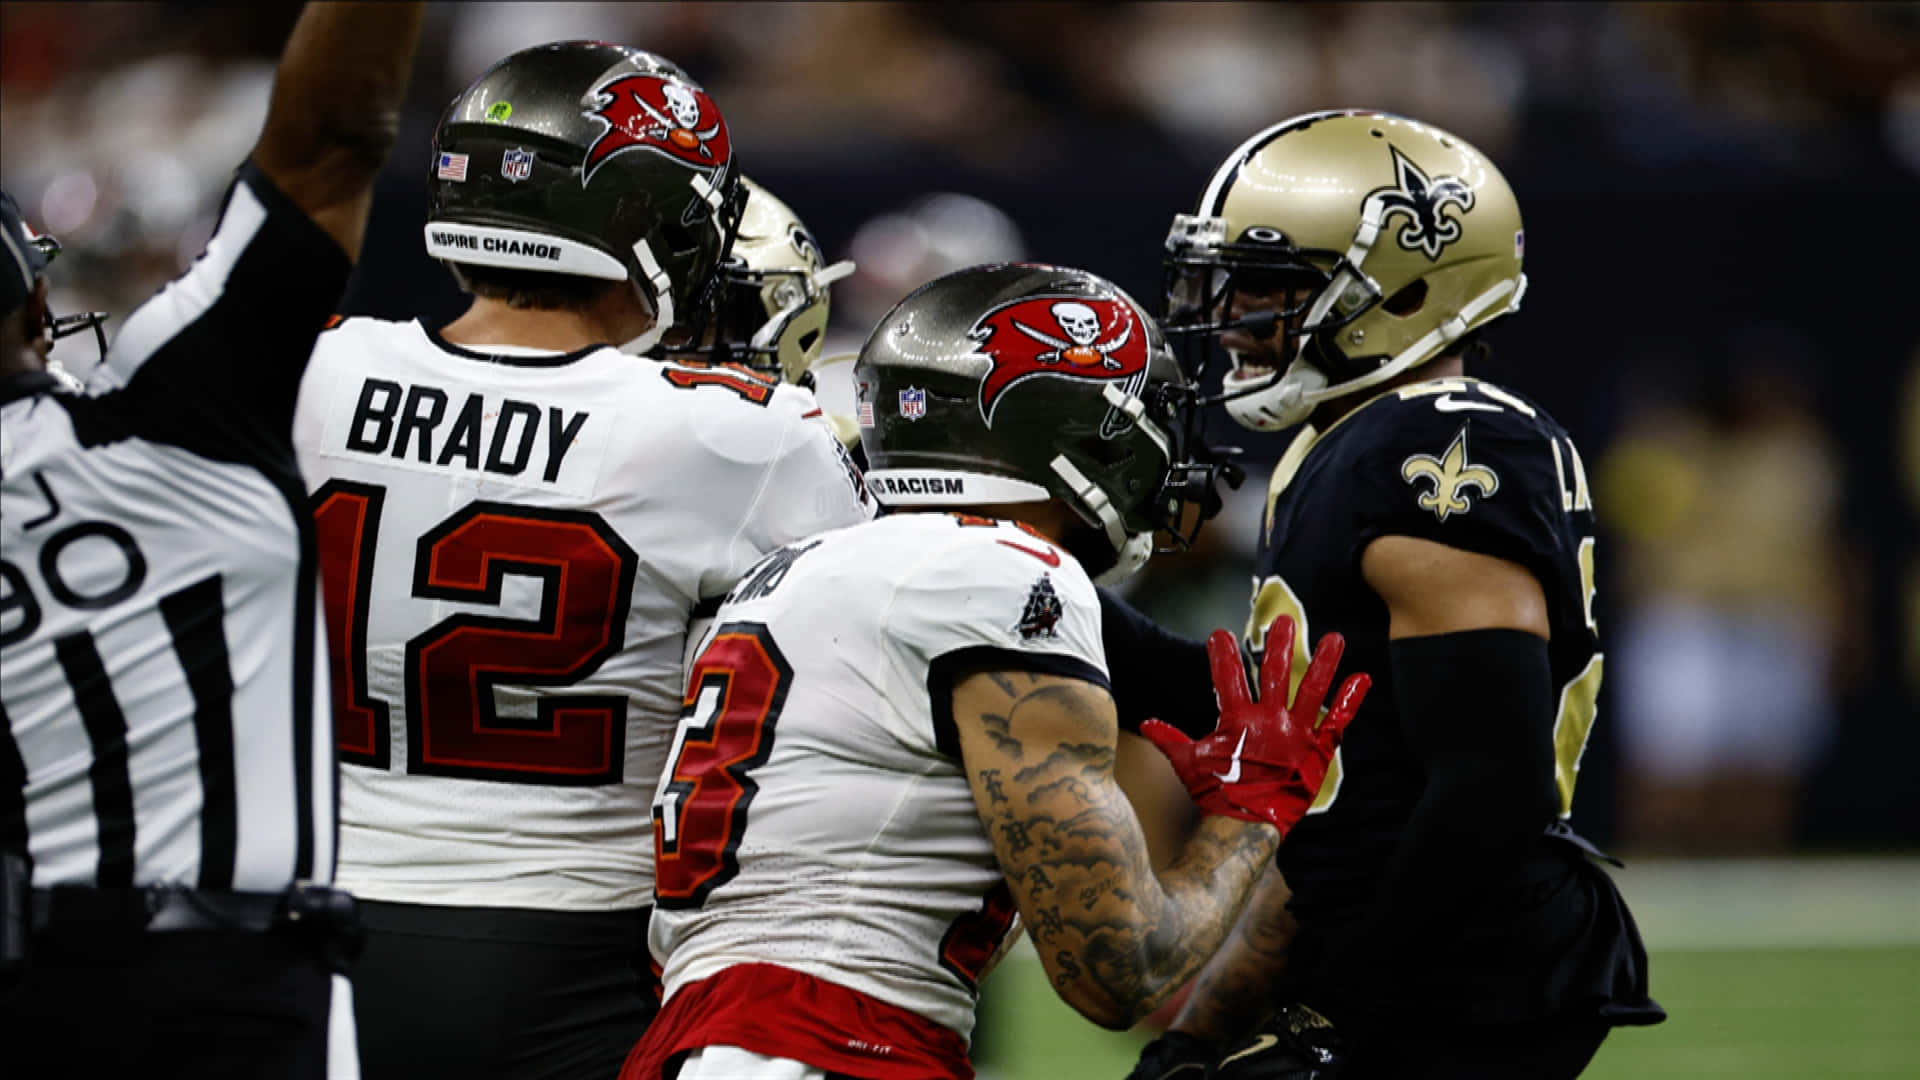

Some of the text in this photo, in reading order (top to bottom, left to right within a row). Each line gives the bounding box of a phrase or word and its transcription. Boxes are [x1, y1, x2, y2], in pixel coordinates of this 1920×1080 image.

[505, 162, 527, 177] NFL
[431, 231, 561, 261] INSPIRE CHANGE
[903, 401, 925, 416] NFL
[346, 377, 590, 484] BRADY
[884, 477, 964, 495] RACISM
[306, 478, 639, 787] 12
